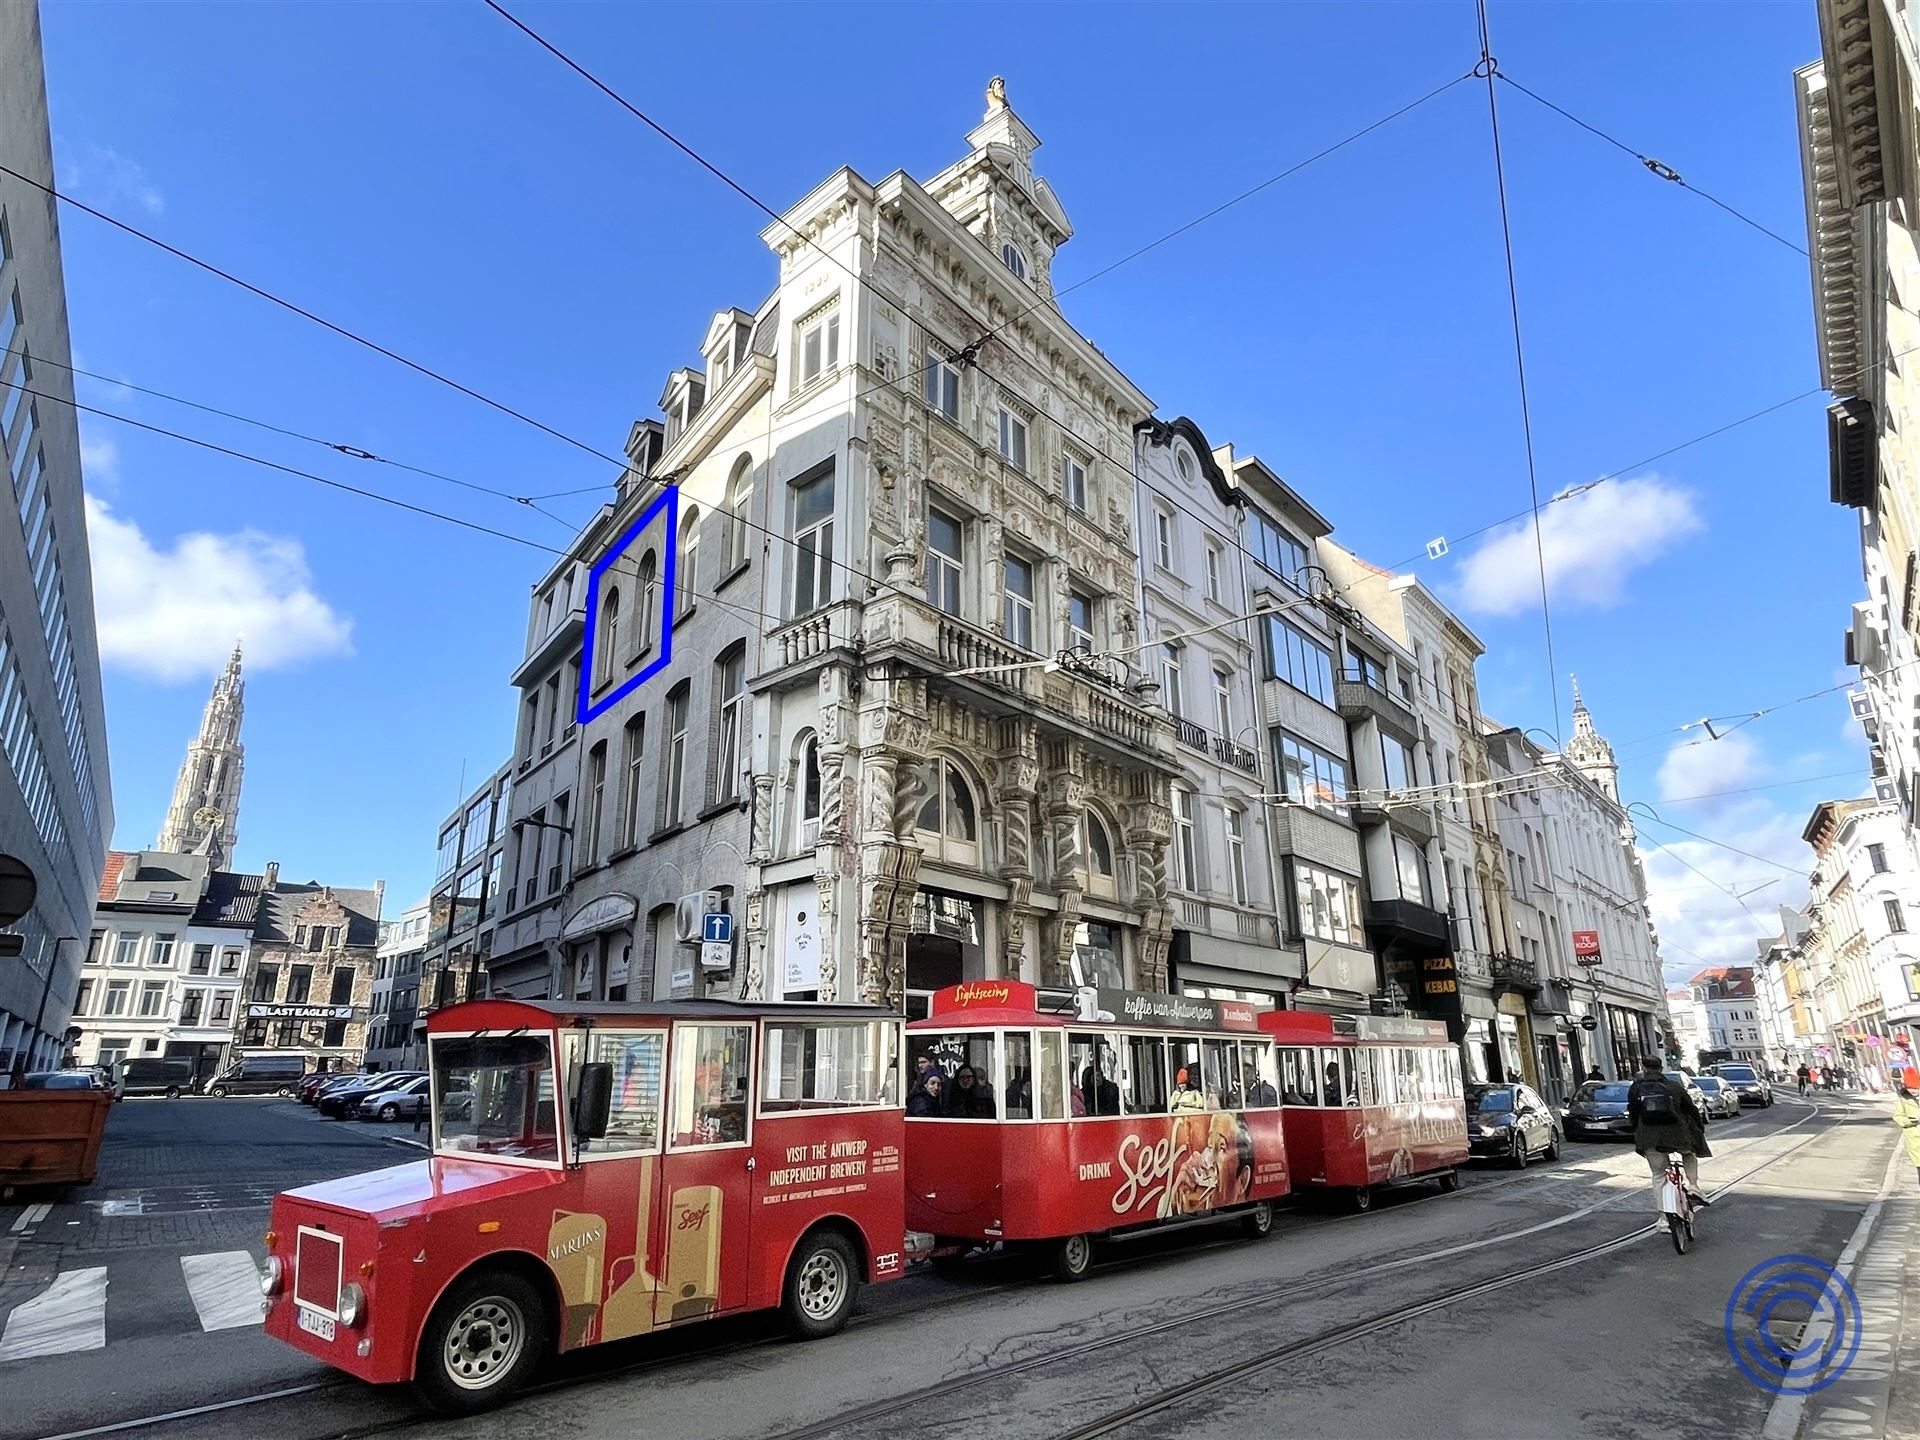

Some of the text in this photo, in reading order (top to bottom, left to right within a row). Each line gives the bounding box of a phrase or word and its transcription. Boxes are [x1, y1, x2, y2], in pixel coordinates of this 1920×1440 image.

[1575, 941, 1597, 949] KOOP
[1424, 957, 1453, 970] PIZZA
[955, 983, 1008, 1007] Sightseeing
[1425, 980, 1457, 994] KEBAB
[267, 1007, 328, 1017] LAST EAGLE
[1124, 996, 1214, 1022] koffie van Antwerpen
[786, 1140, 867, 1164] VISIT THE ANTWERP
[769, 1165, 827, 1187] INDEPENDENT
[830, 1160, 867, 1179] BREWERY
[1079, 1161, 1112, 1182] DRINK
[1111, 1117, 1187, 1219] Seef
[677, 1203, 710, 1231] Seef
